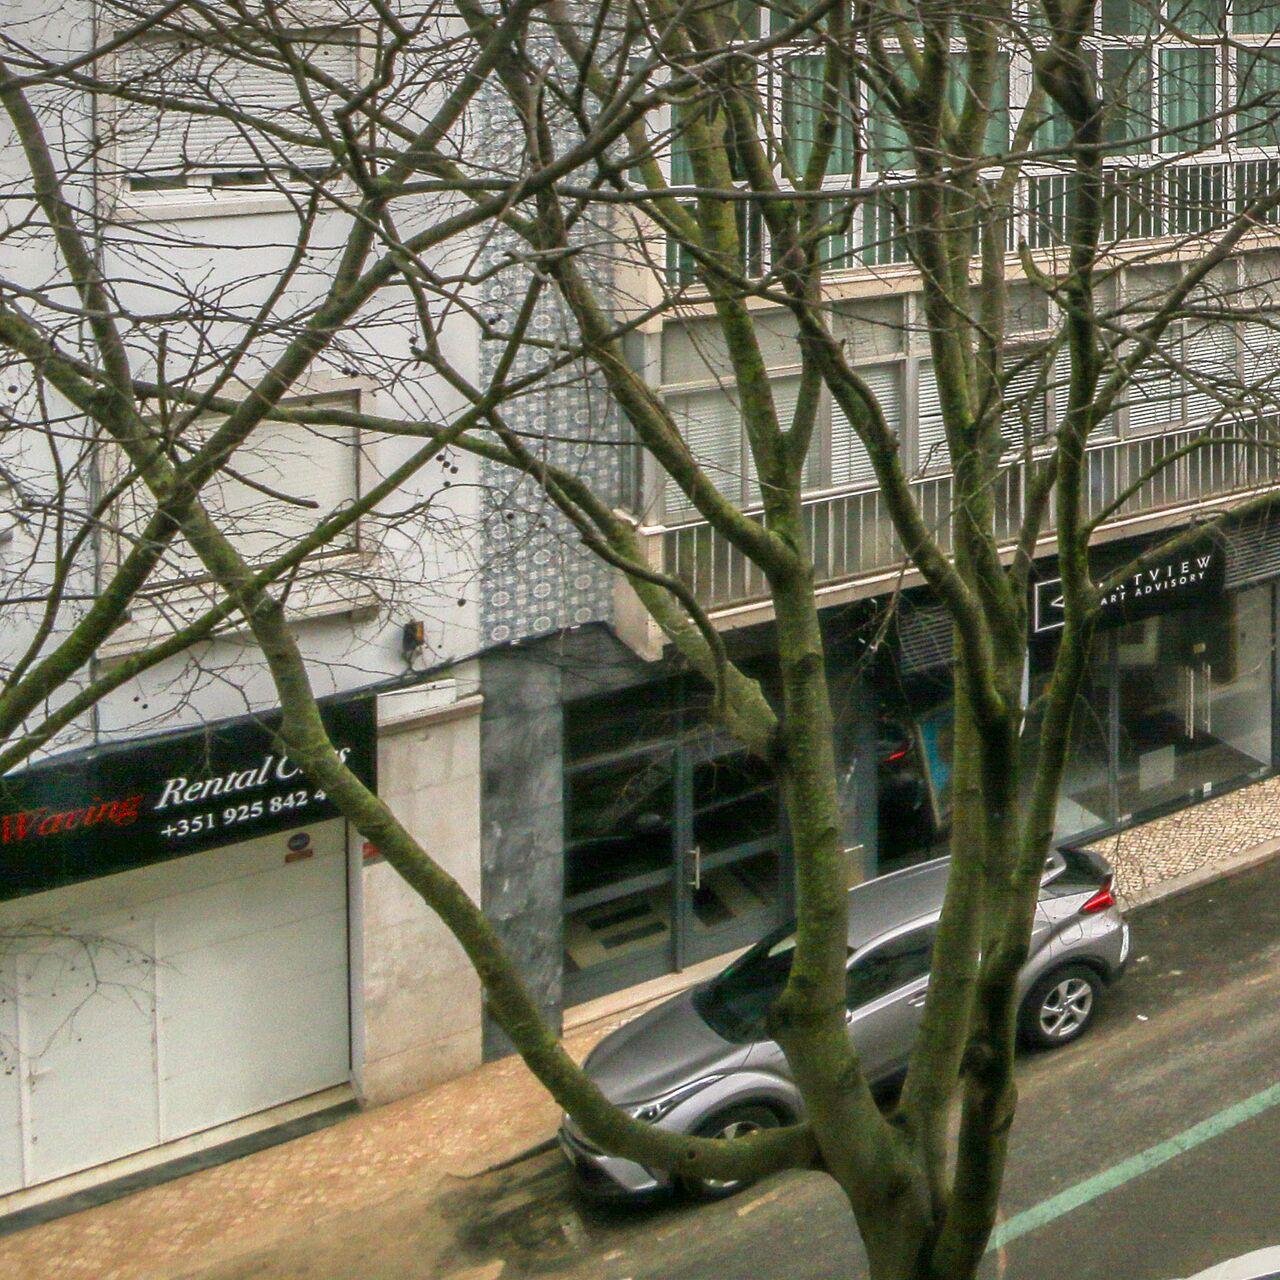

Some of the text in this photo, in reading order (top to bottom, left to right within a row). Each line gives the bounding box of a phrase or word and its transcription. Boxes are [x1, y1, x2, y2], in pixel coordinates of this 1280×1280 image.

[1099, 556, 1211, 591] TVIEW
[1101, 572, 1205, 606] ART ADVISORY
[154, 755, 274, 811] Rental
[161, 813, 214, 838] +351
[223, 801, 264, 826] 925
[270, 790, 308, 812] 842
